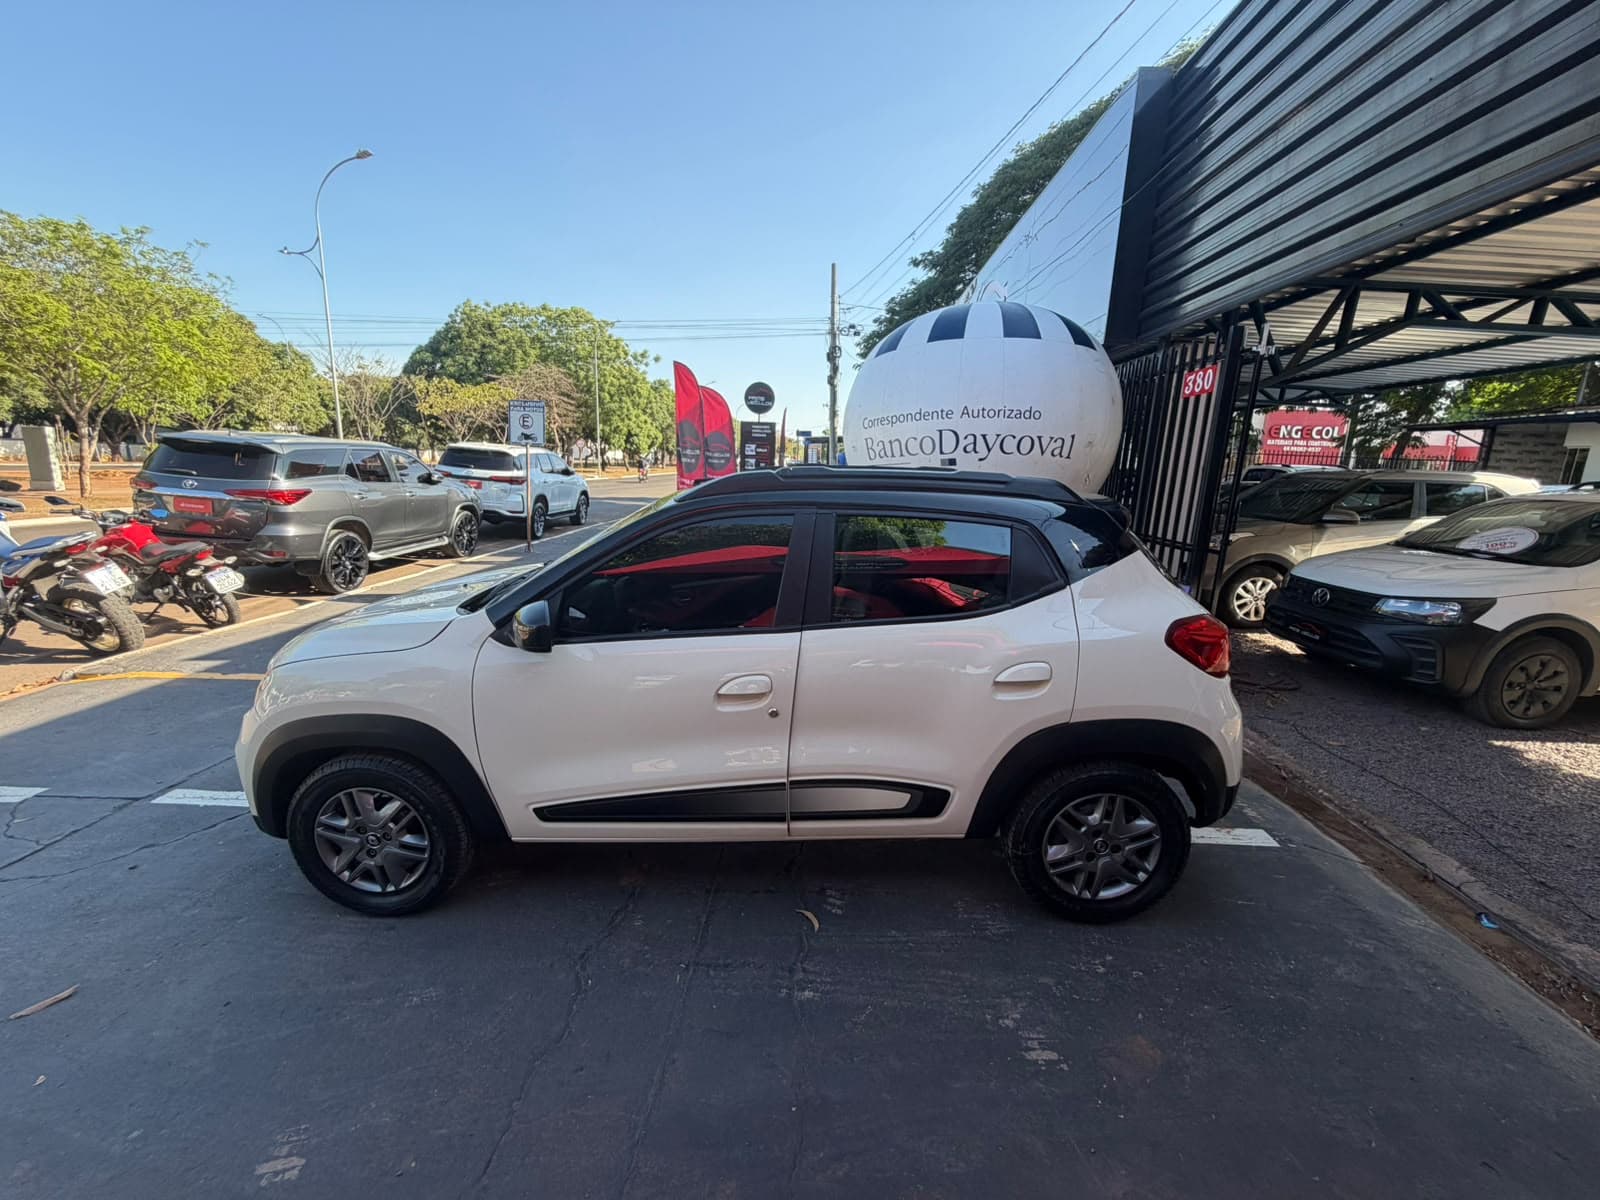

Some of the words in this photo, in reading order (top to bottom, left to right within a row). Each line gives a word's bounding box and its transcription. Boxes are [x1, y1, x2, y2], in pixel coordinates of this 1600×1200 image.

[1184, 368, 1214, 394] 380
[862, 408, 954, 430] Correspondente
[960, 405, 1042, 421] Autorizado
[1269, 424, 1340, 439] ENGECOL
[1294, 439, 1307, 447] PARA
[864, 428, 1076, 462] BancoDaycoval
